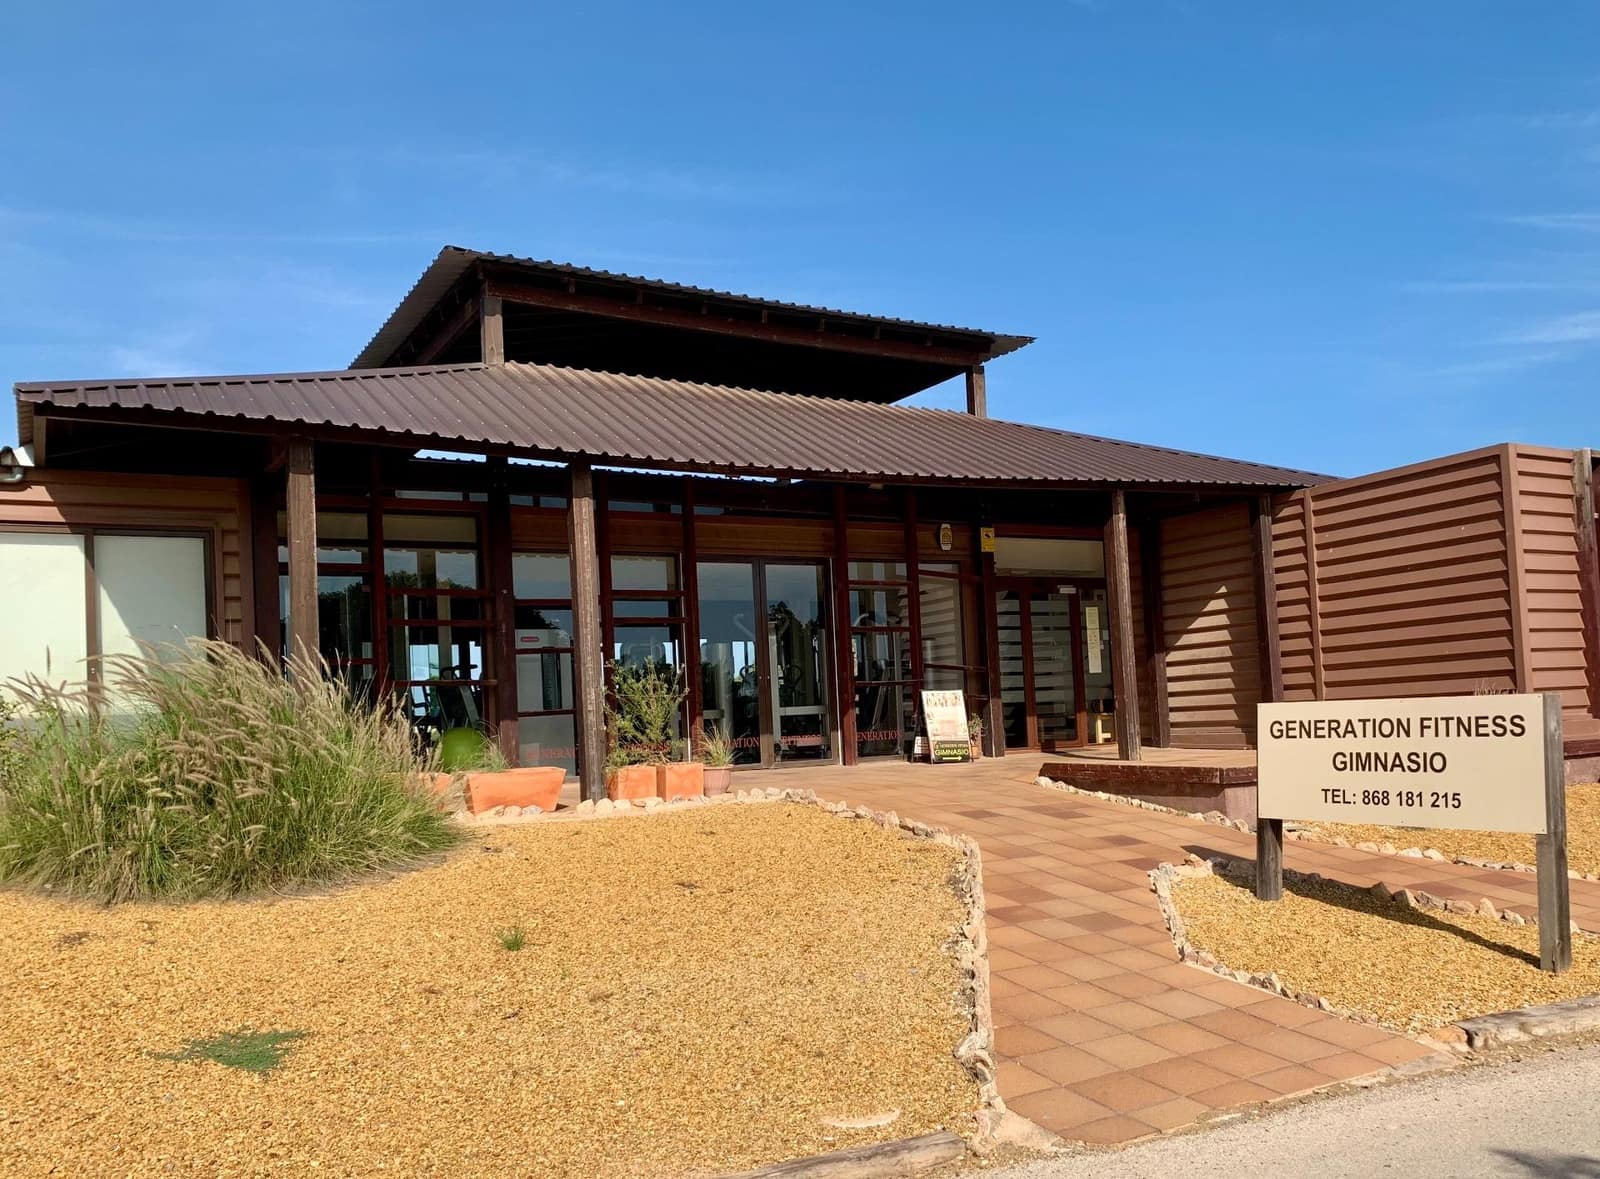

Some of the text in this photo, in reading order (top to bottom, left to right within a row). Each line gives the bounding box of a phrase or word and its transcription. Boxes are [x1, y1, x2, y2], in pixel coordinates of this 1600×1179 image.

[855, 729, 904, 742] ENERATION
[1270, 715, 1525, 739] GENERATION FITNESS
[934, 748, 969, 756] GIMNASIO
[1333, 752, 1446, 773] GIMNASIO
[1321, 789, 1461, 808] TEL: 868 181 215
